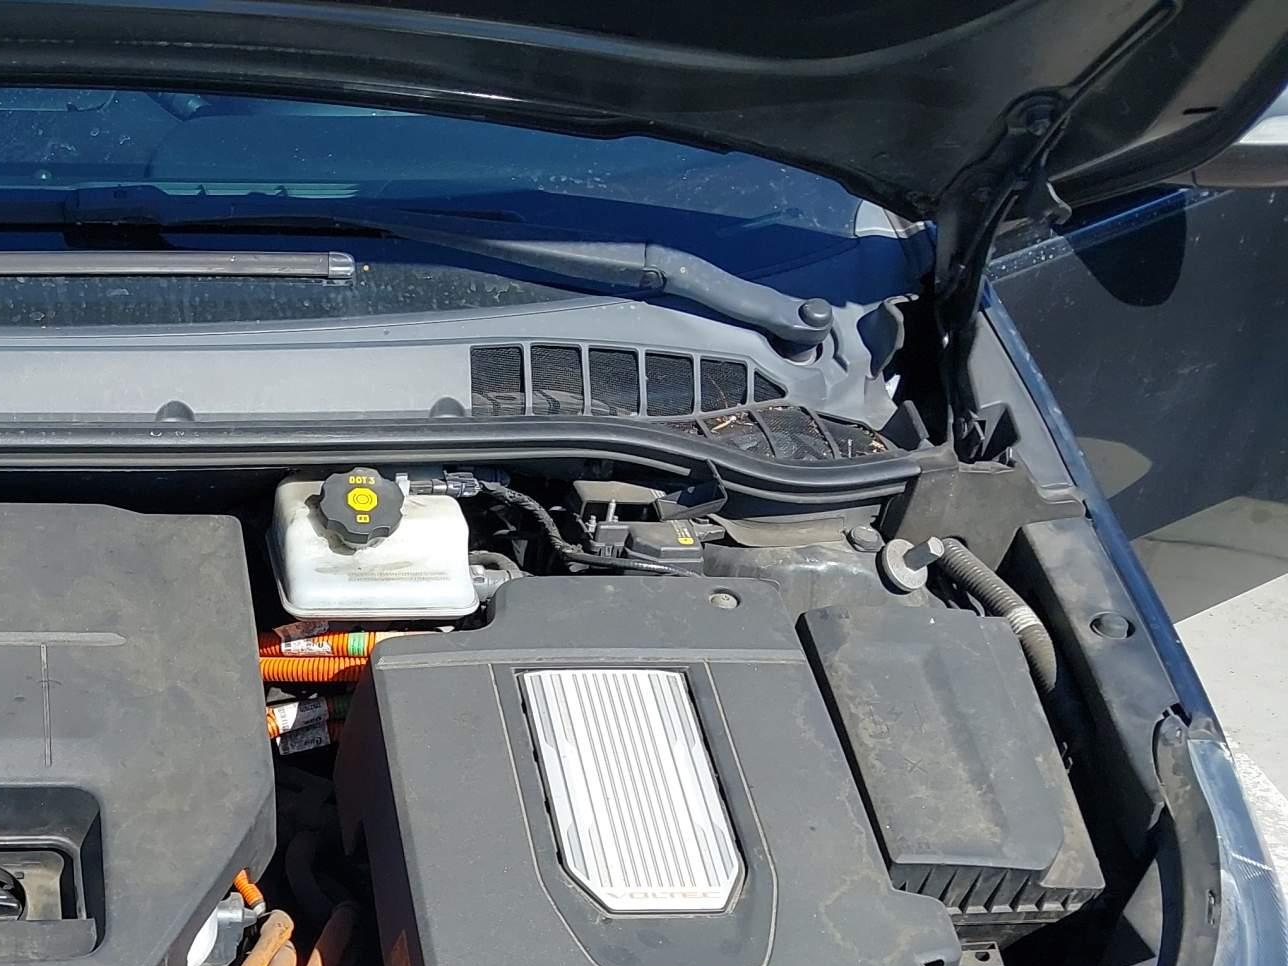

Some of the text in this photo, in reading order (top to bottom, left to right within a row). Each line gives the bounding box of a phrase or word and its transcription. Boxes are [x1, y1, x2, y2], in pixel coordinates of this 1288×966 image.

[348, 475, 376, 485] DOT 3
[605, 891, 721, 899] VOLTEC
